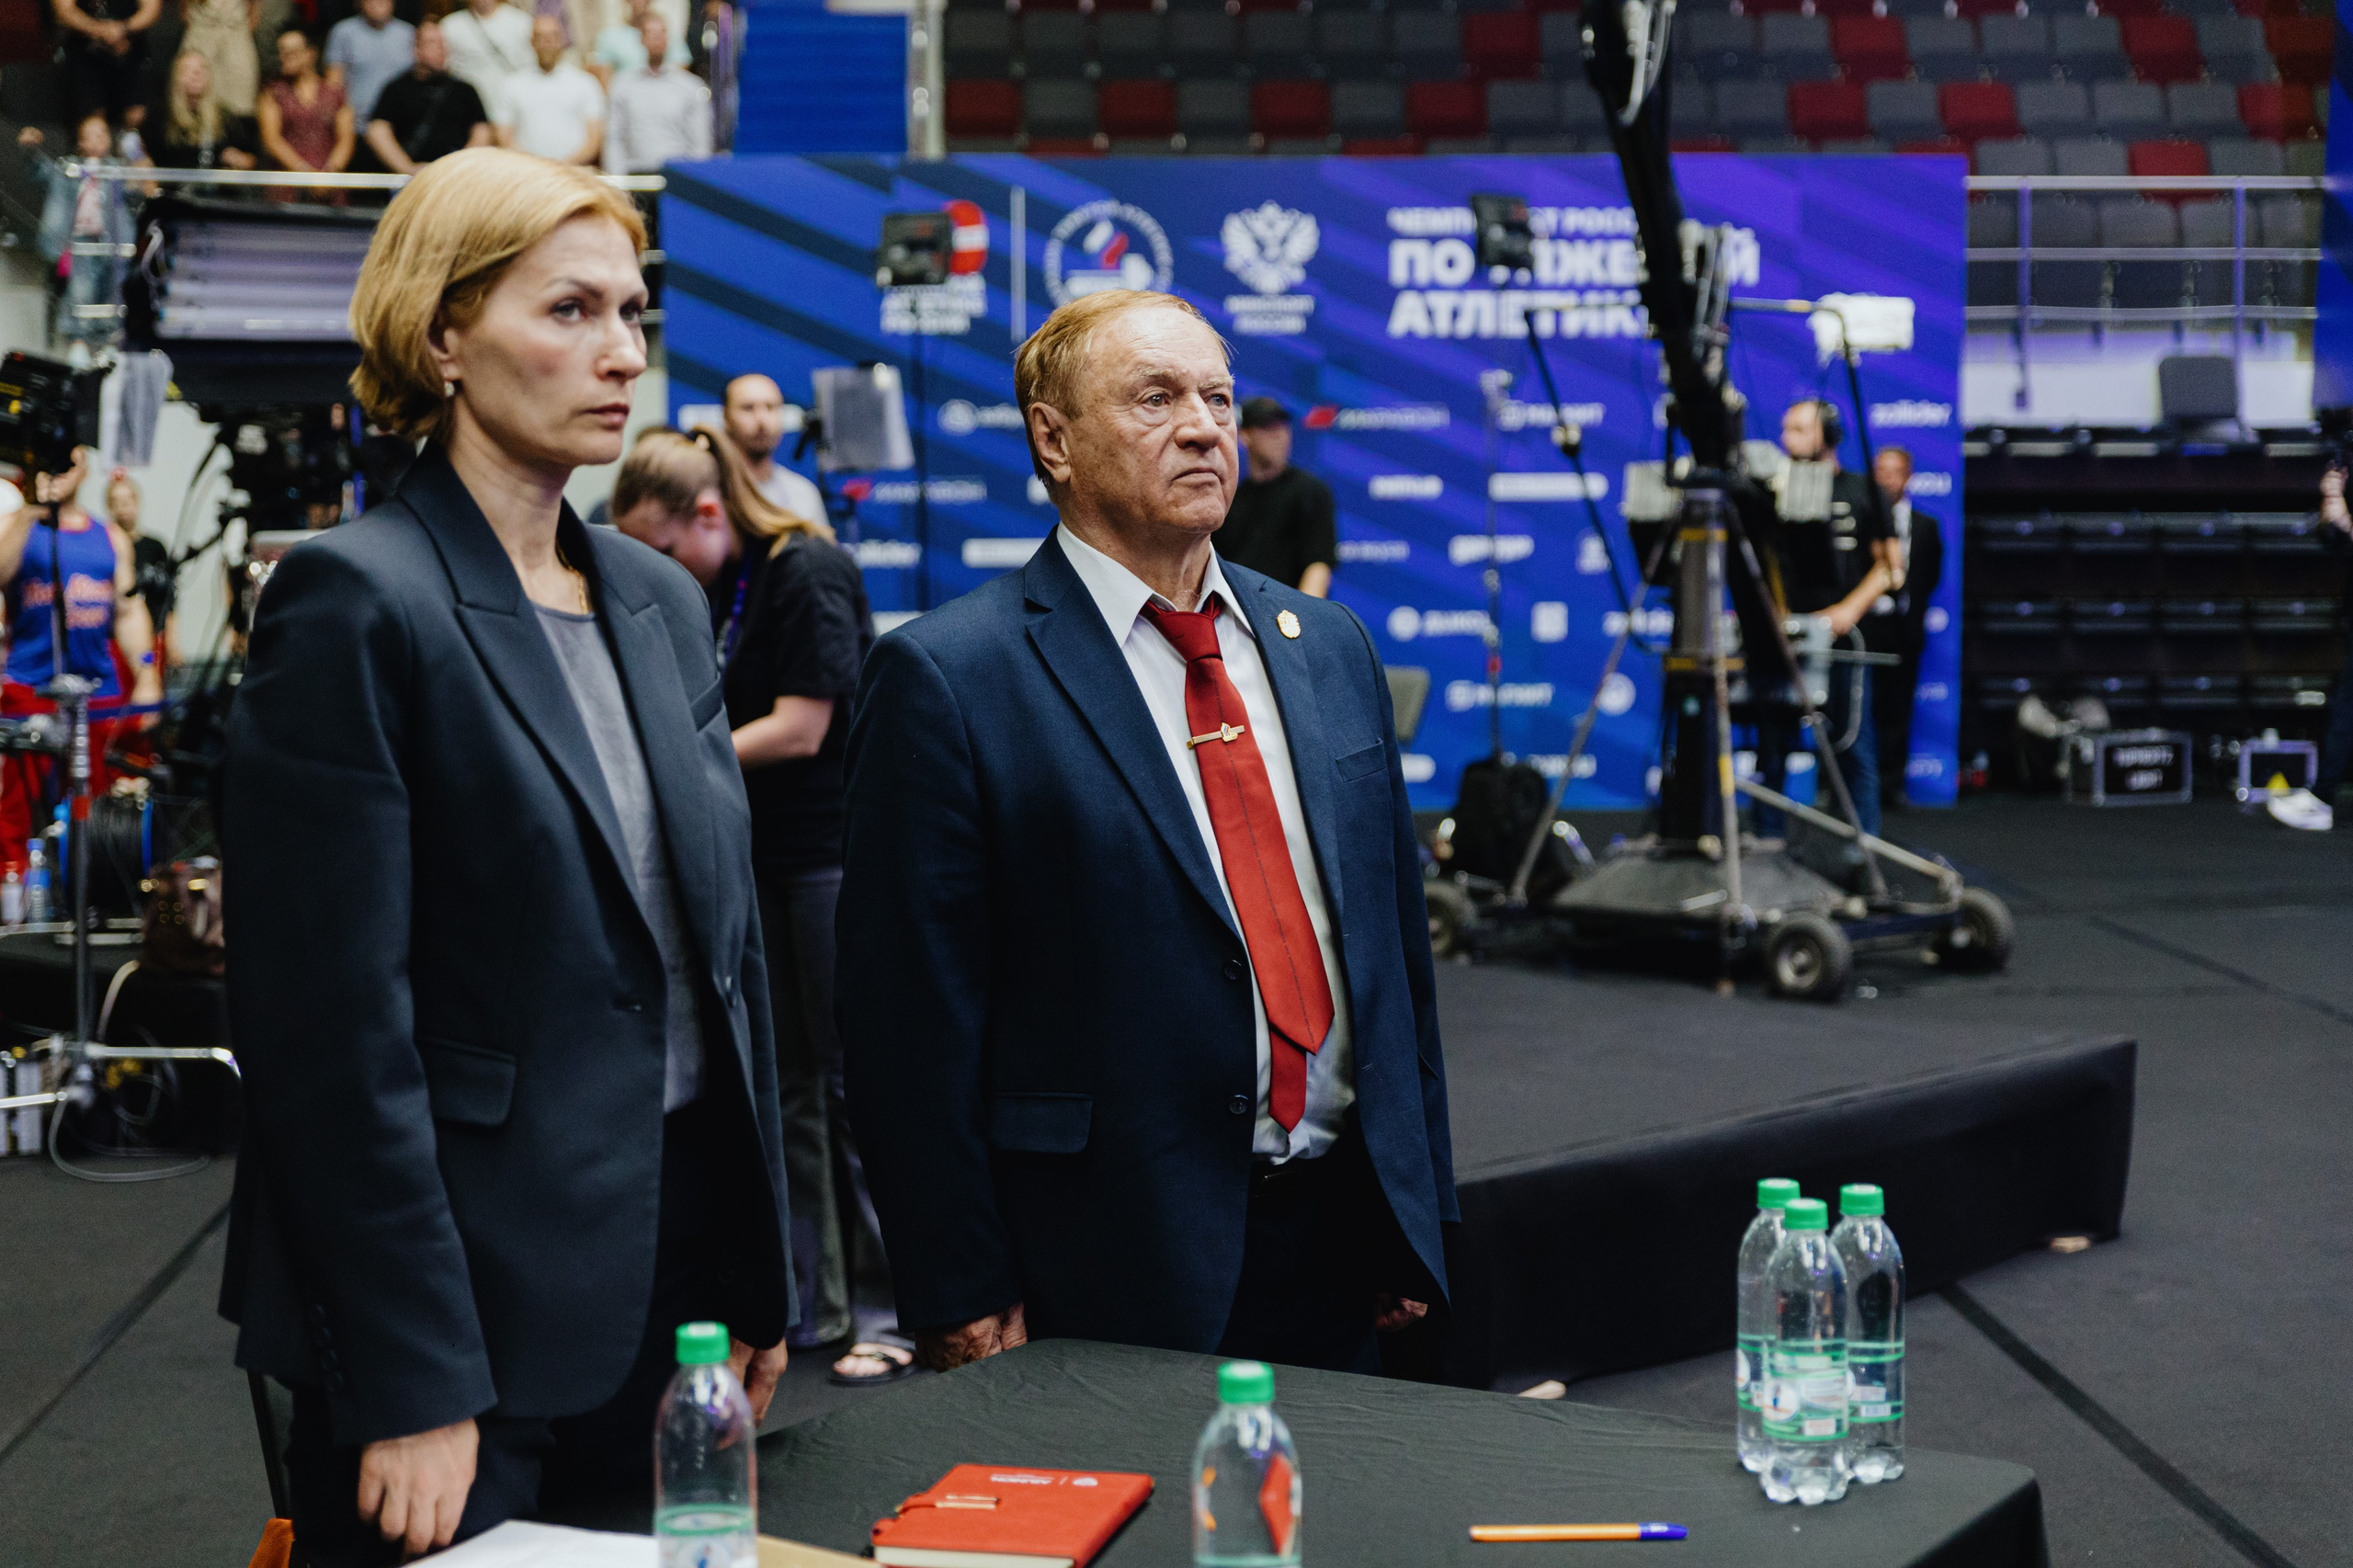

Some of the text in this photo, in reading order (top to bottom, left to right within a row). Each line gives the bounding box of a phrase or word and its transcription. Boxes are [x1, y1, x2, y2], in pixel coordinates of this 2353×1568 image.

[1387, 207, 1560, 236] ЧЕМПАТ
[1388, 239, 1476, 288] ПО
[1387, 290, 1651, 339] АТЛЕТИК
